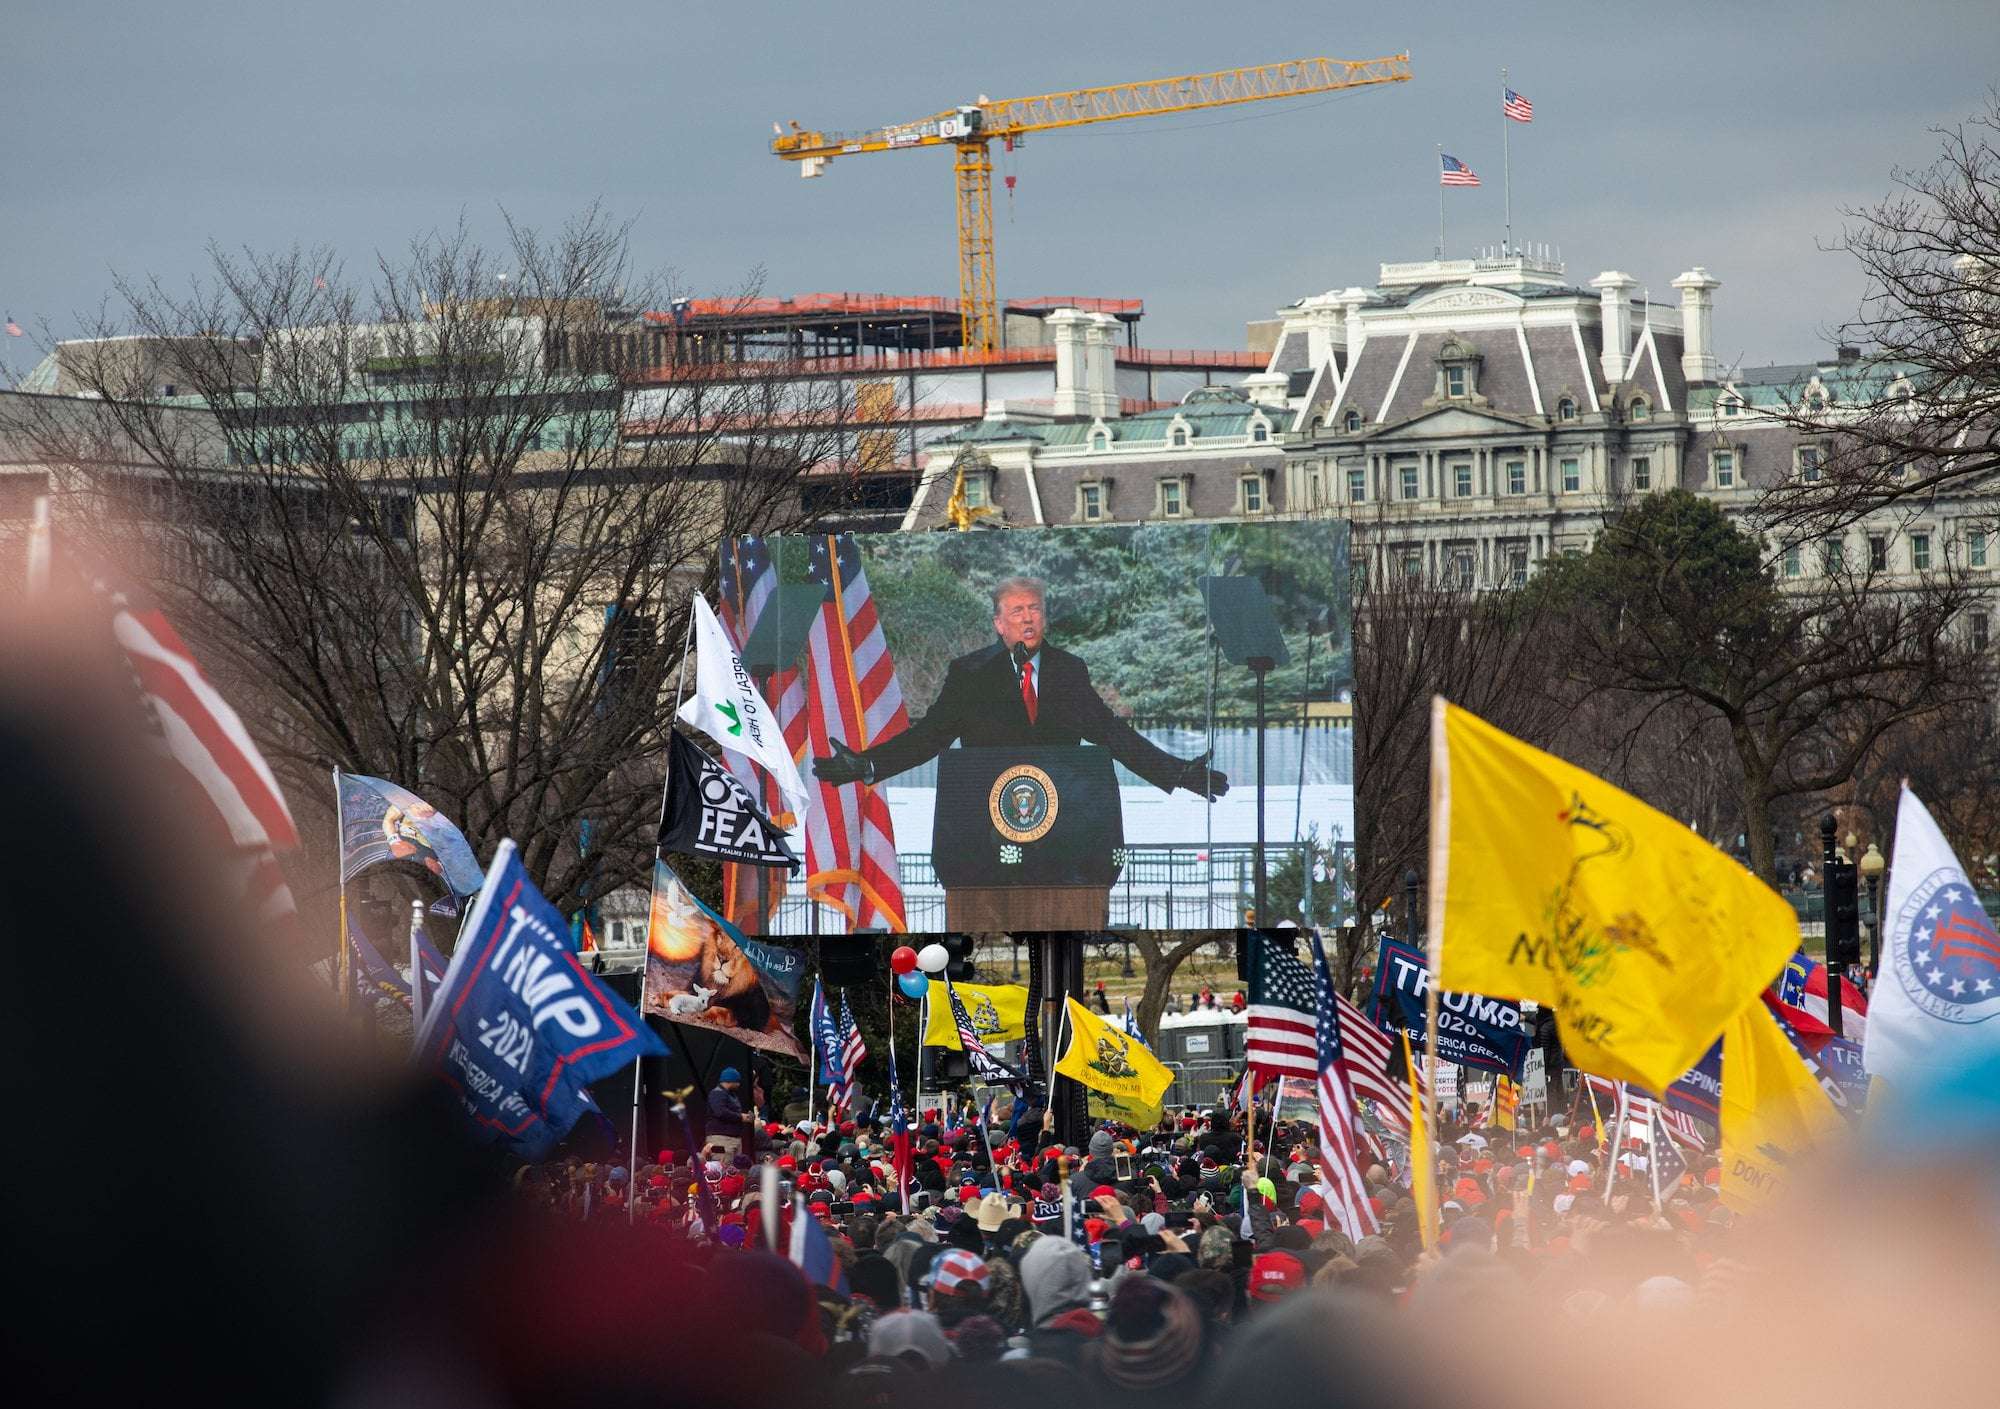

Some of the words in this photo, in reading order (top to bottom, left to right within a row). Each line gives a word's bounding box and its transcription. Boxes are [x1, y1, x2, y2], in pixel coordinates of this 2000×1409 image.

[698, 807, 777, 852] FEA
[1420, 1033, 1466, 1051] AERICA
[1832, 1047, 1863, 1066] TR
[1680, 1068, 1723, 1097] EPING
[1034, 1203, 1063, 1215] TRU
